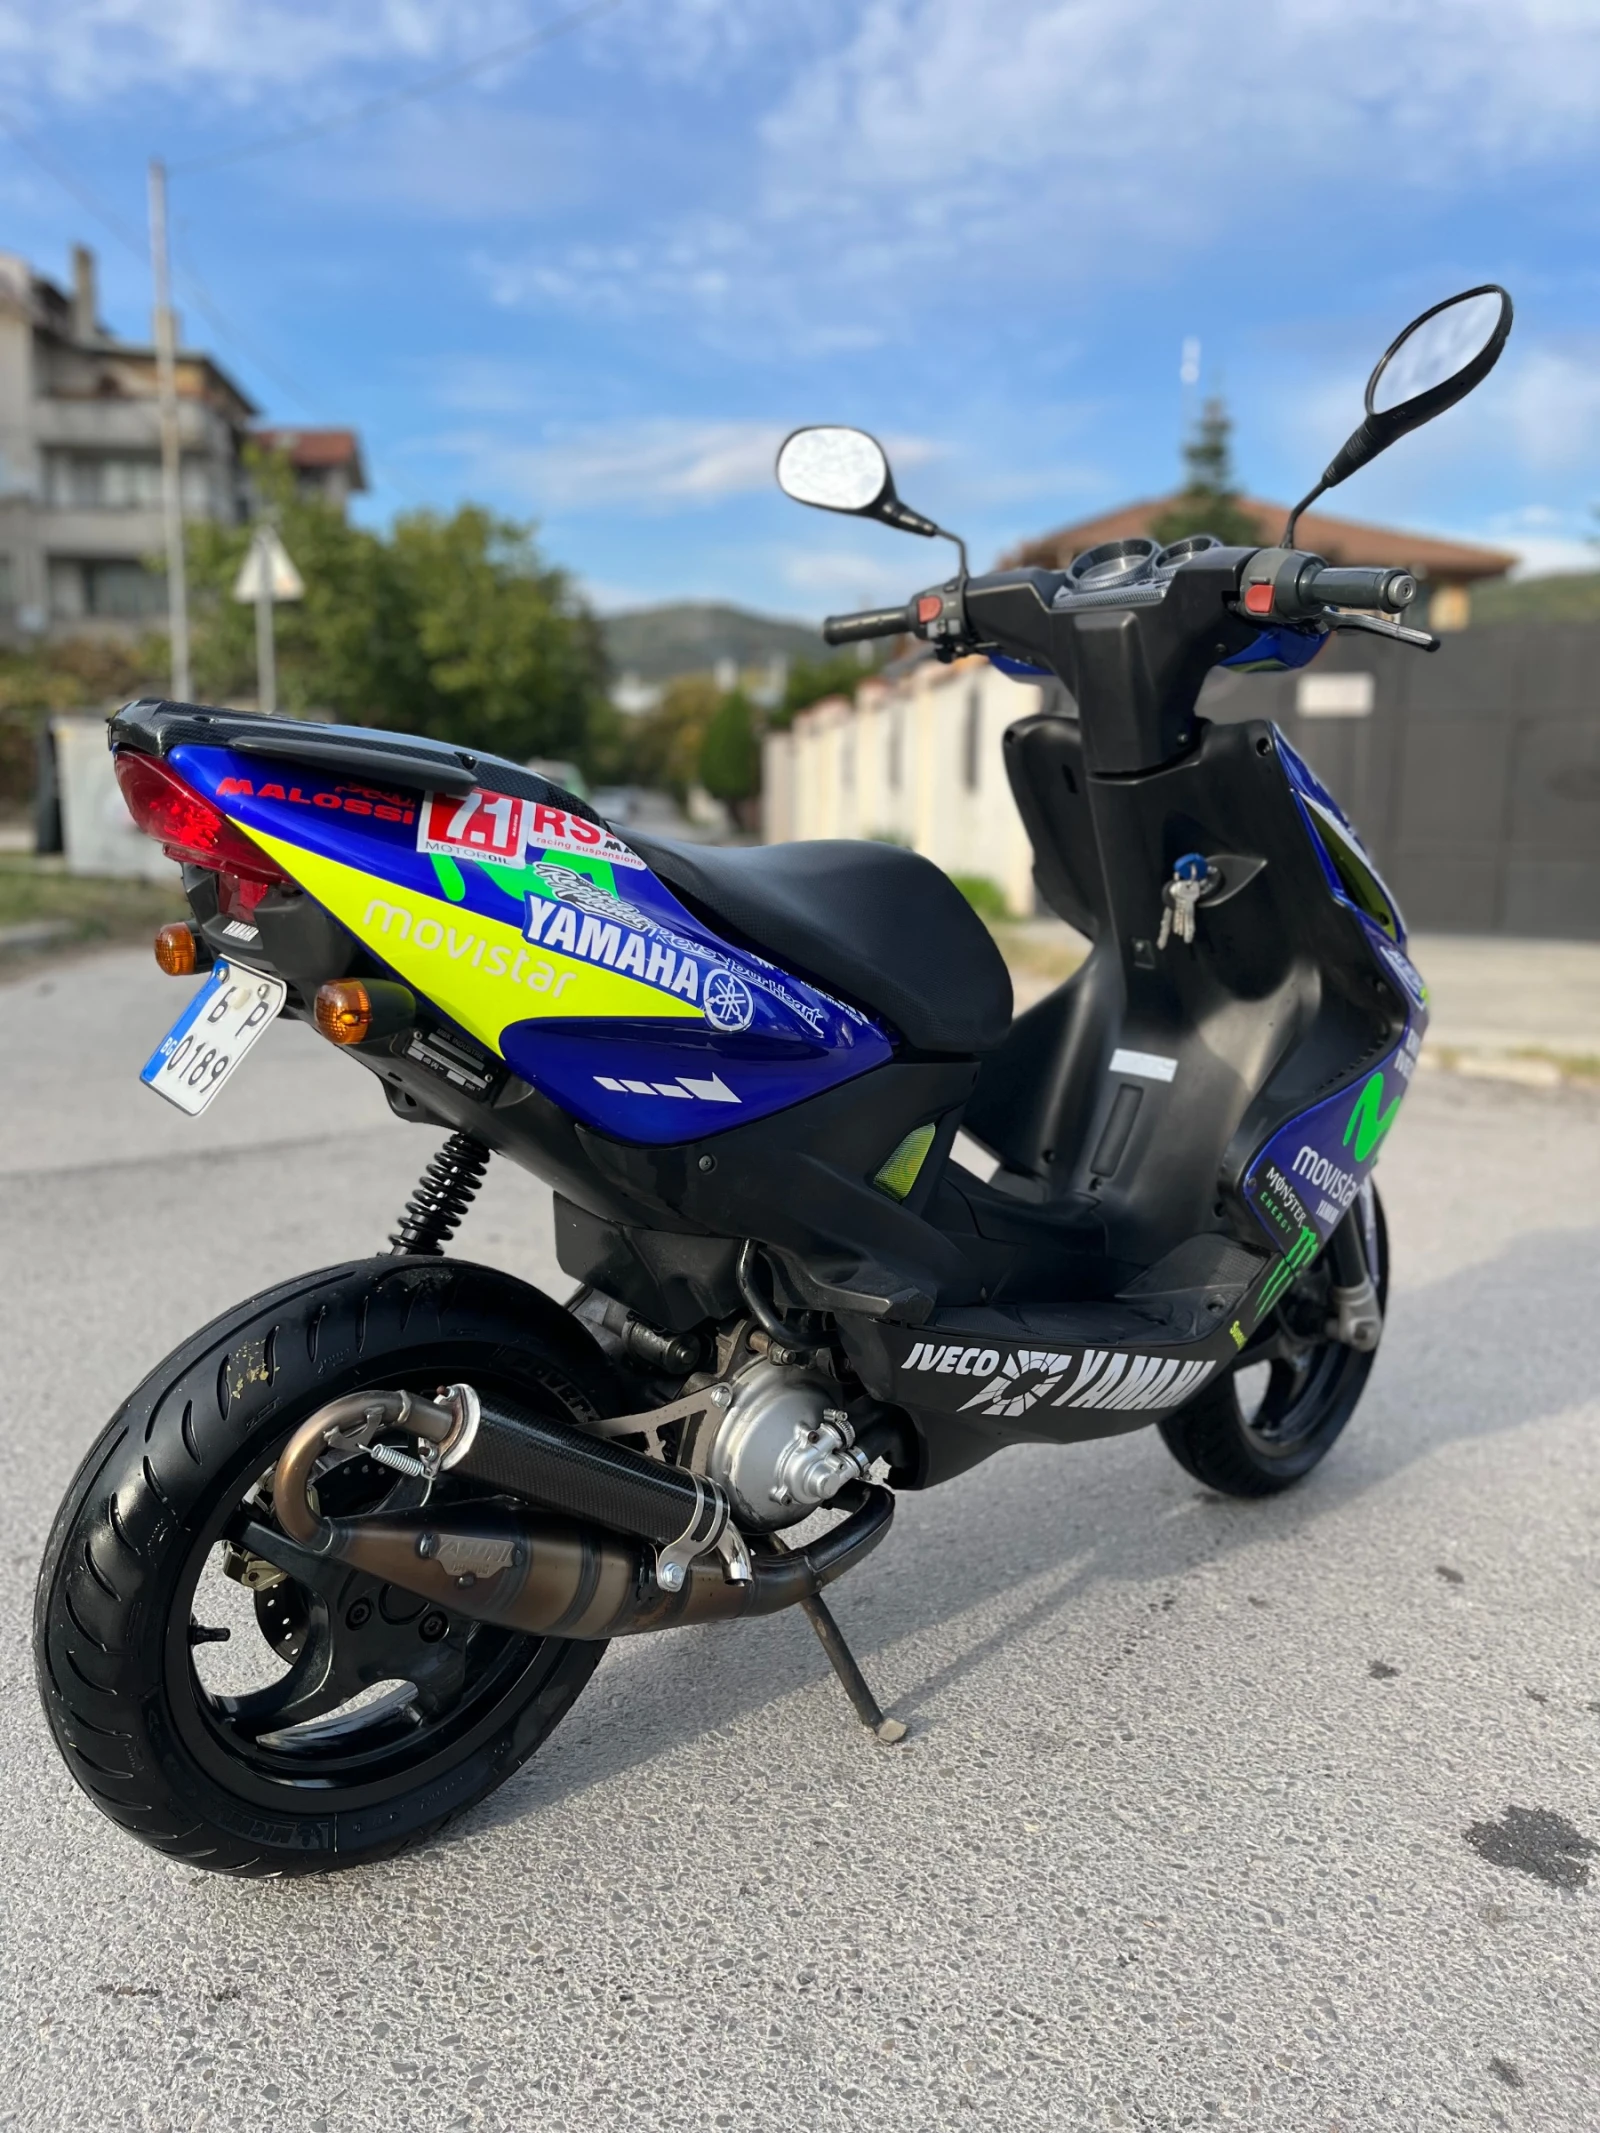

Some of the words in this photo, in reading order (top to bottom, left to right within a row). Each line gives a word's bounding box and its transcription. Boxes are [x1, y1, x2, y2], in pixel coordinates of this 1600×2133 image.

[216, 777, 414, 825] MALOSSI
[425, 841, 510, 865] MOTOROIL
[536, 837, 571, 850] racing
[575, 845, 643, 867] suspensions
[362, 899, 578, 999] movistar
[527, 895, 699, 1001] YAMAHA
[166, 1035, 229, 1094] 0189
[1260, 1191, 1292, 1234] ENERGY
[901, 1342, 1000, 1377] IVECO
[1050, 1349, 1217, 1410] YAMAHA
